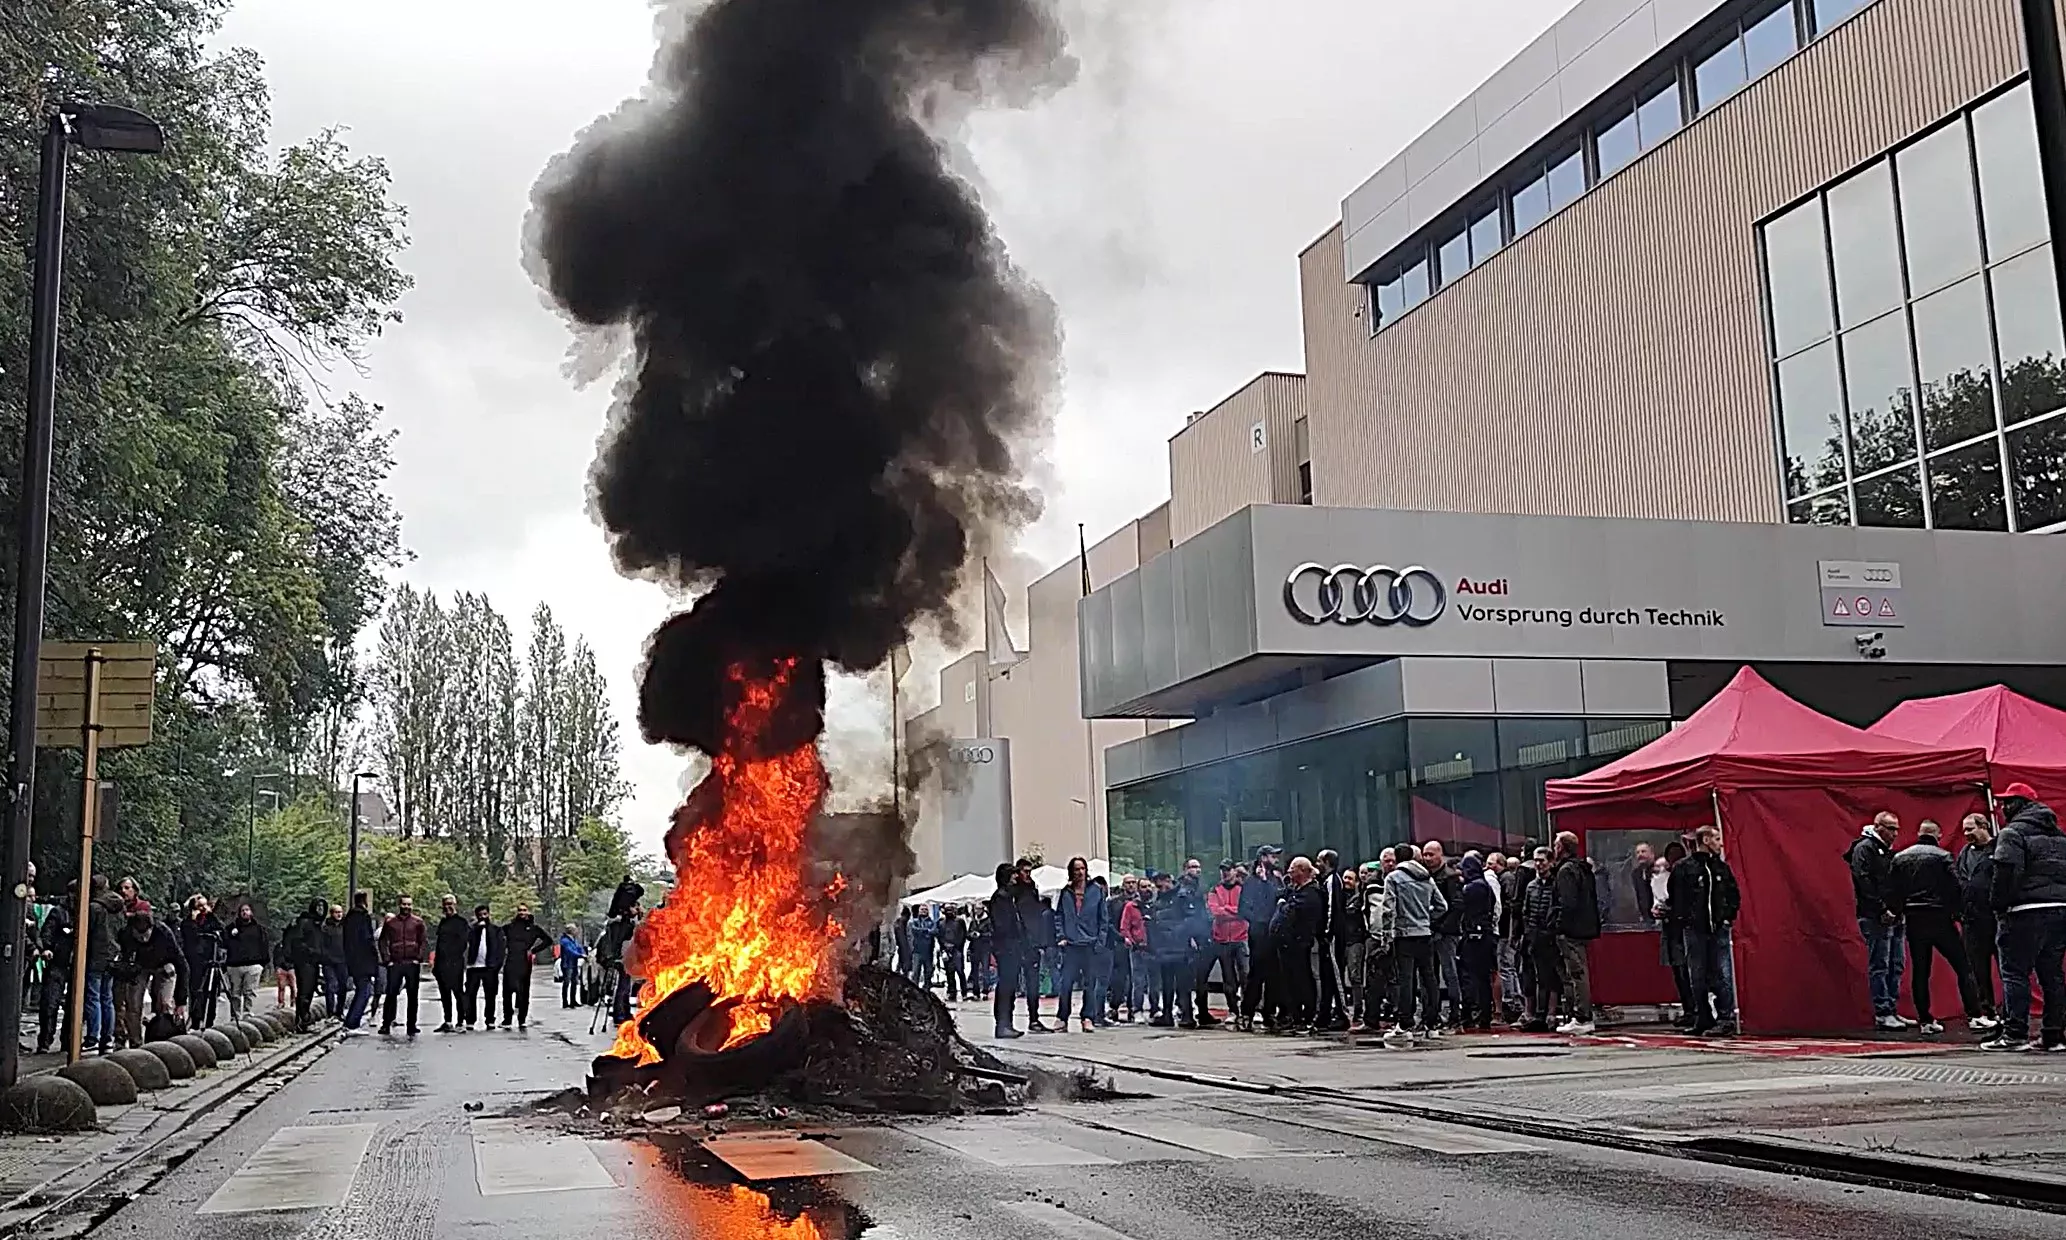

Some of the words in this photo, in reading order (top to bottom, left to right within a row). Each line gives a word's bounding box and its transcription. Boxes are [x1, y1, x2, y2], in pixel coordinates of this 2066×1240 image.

[1254, 428, 1262, 448] R
[1457, 578, 1508, 595] Audi
[1457, 604, 1572, 627] Vorsprung
[1579, 608, 1640, 624] durch
[1645, 608, 1725, 626] Technik
